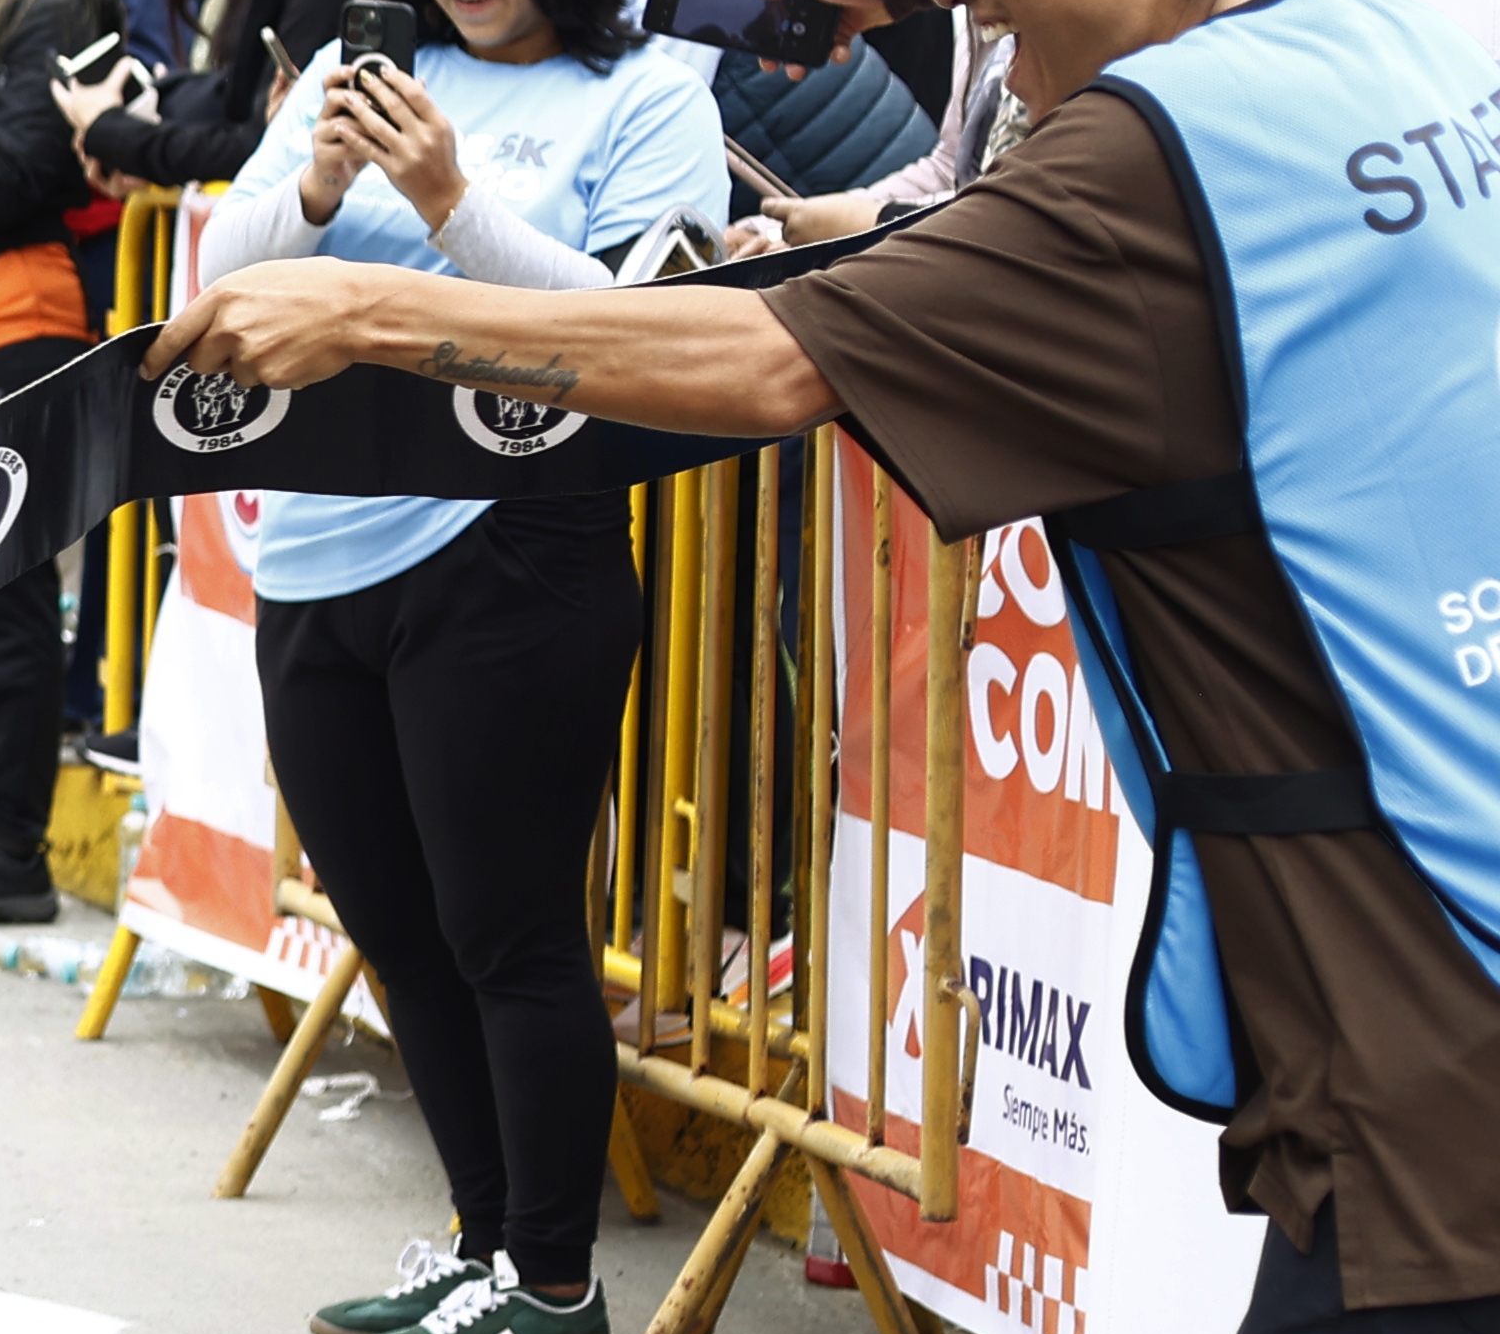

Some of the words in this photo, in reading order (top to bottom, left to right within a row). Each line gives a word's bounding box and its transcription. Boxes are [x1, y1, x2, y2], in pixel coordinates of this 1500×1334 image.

[197, 431, 245, 450] 1984
[498, 436, 547, 454] 1984
[961, 952, 1092, 1091] RIMAX
[1002, 1083, 1048, 1142] Siempre
[1052, 1107, 1091, 1156] Más.
